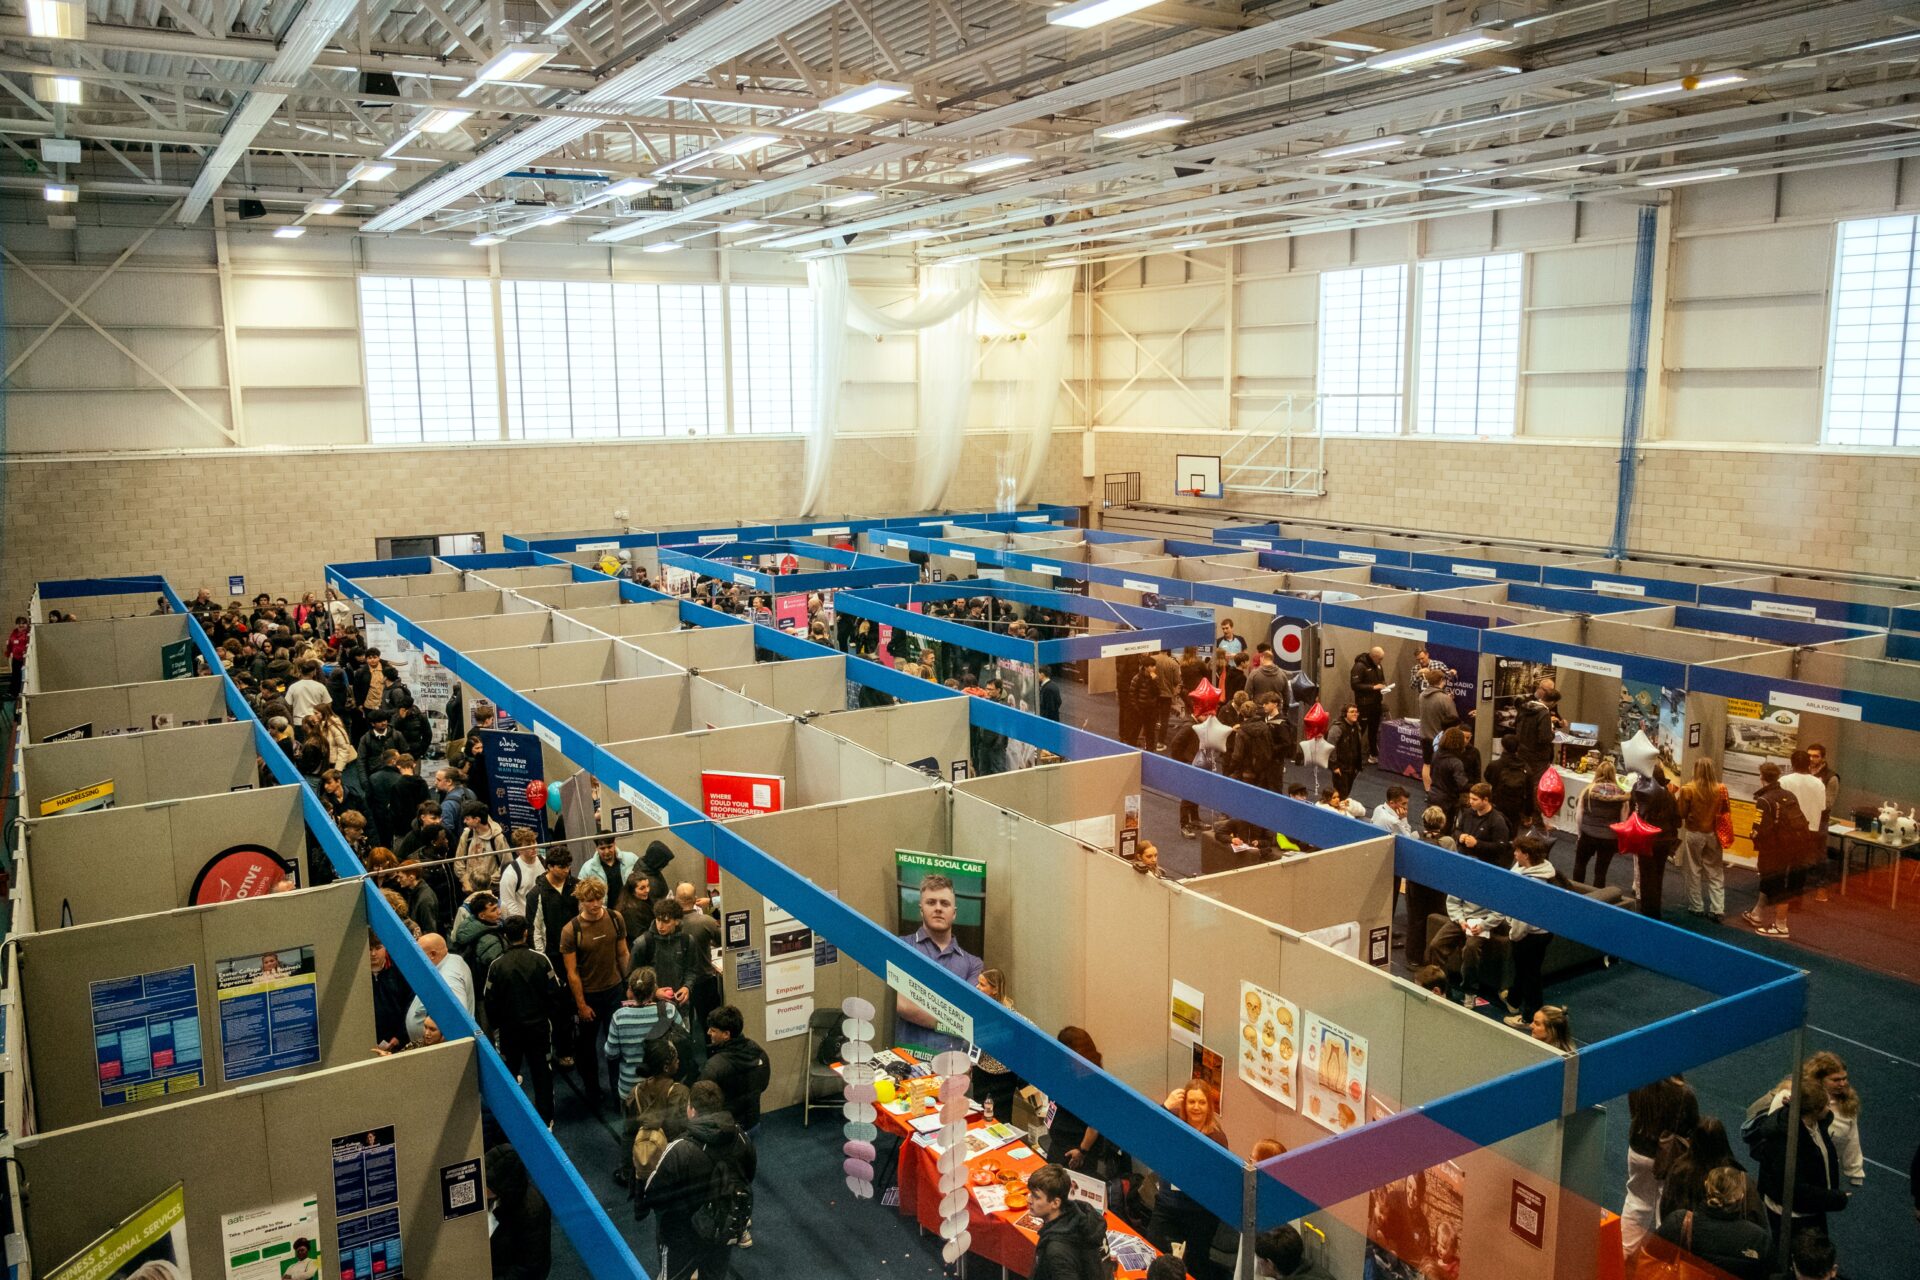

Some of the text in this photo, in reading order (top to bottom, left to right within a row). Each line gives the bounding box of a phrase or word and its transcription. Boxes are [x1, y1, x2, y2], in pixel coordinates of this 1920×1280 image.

[1446, 688, 1467, 696] EVON
[1821, 704, 1840, 712] FOODS
[1400, 734, 1420, 746] Devon
[56, 788, 99, 806] HAIRDRESSING
[899, 854, 925, 864] HEALTH
[934, 860, 960, 869] SOCIAL
[962, 864, 982, 872] CARE
[776, 984, 804, 995] Empower
[908, 979, 927, 997] EXETER
[948, 1005, 966, 1022] EARLY
[777, 1004, 803, 1014] Promote
[910, 990, 926, 1006] YEARS
[931, 1006, 964, 1033] HEALTHCARE
[775, 1024, 806, 1035] Encourage
[78, 1203, 182, 1280] ROFESSIONAL SERVICES
[99, 1246, 106, 1258] &
